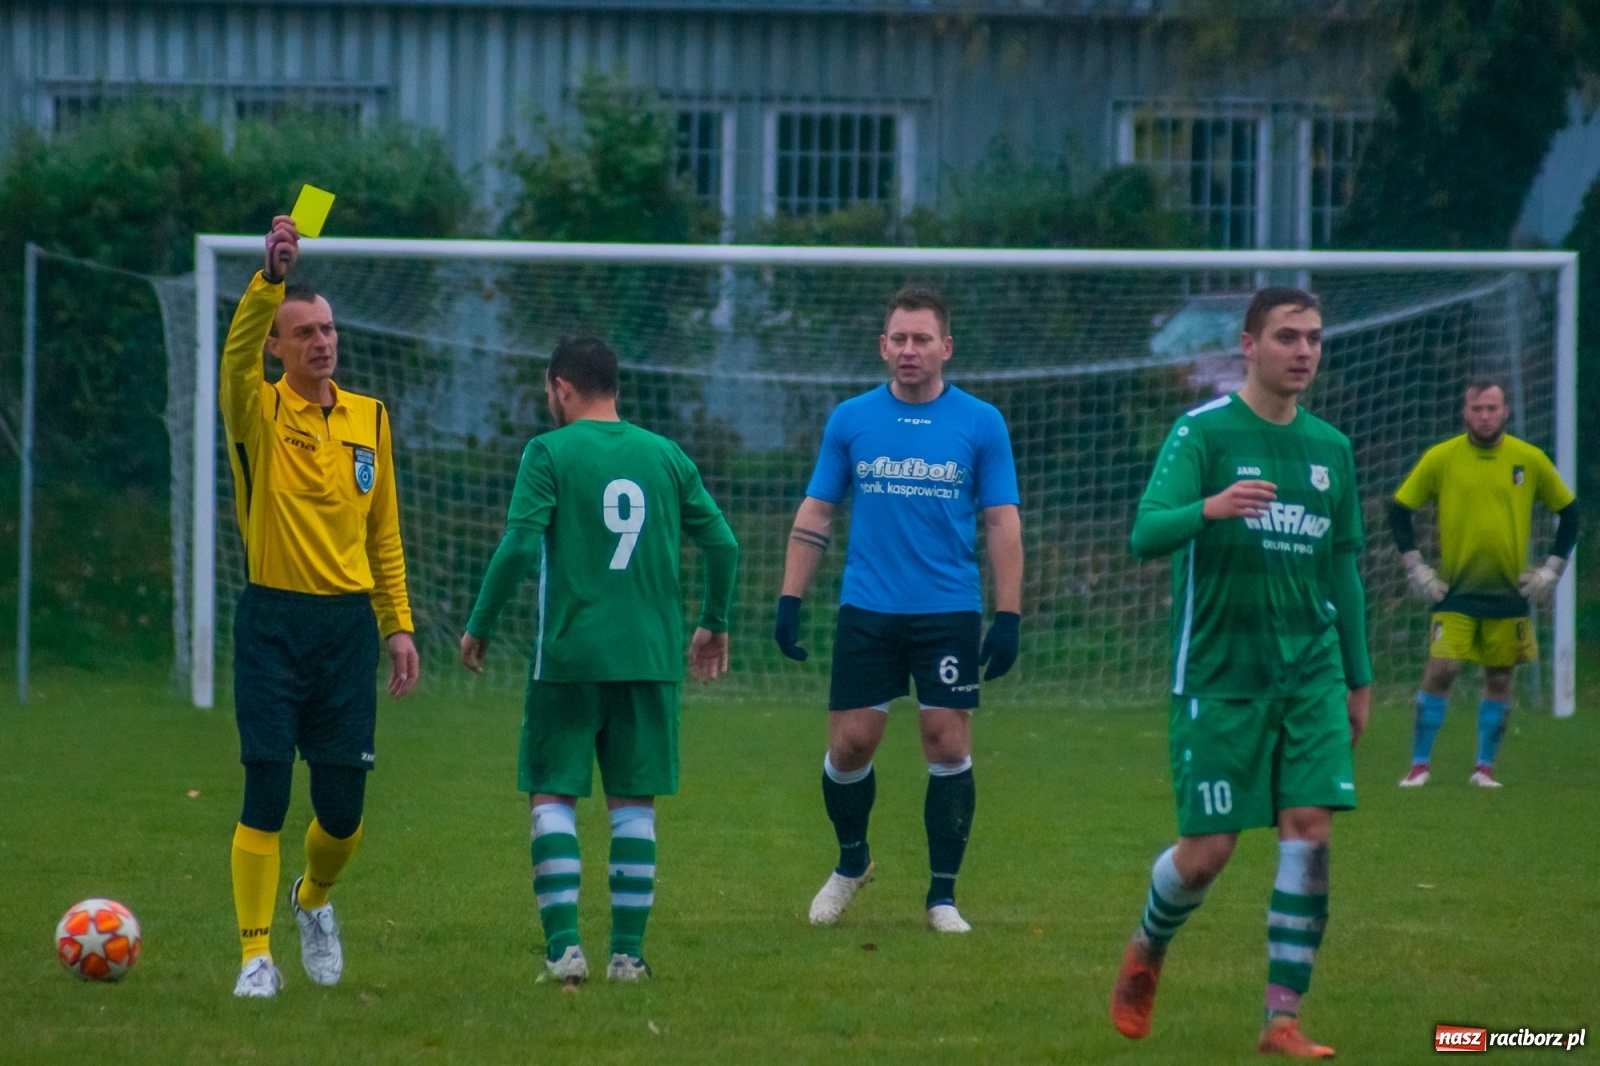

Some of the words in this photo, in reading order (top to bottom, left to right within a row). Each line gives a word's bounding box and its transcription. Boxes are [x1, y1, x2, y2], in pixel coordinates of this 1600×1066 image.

[897, 417, 932, 425] regio
[887, 482, 953, 499] kasprowicza
[603, 478, 645, 570] 9
[939, 655, 959, 684] 6
[1198, 780, 1233, 816] 10
